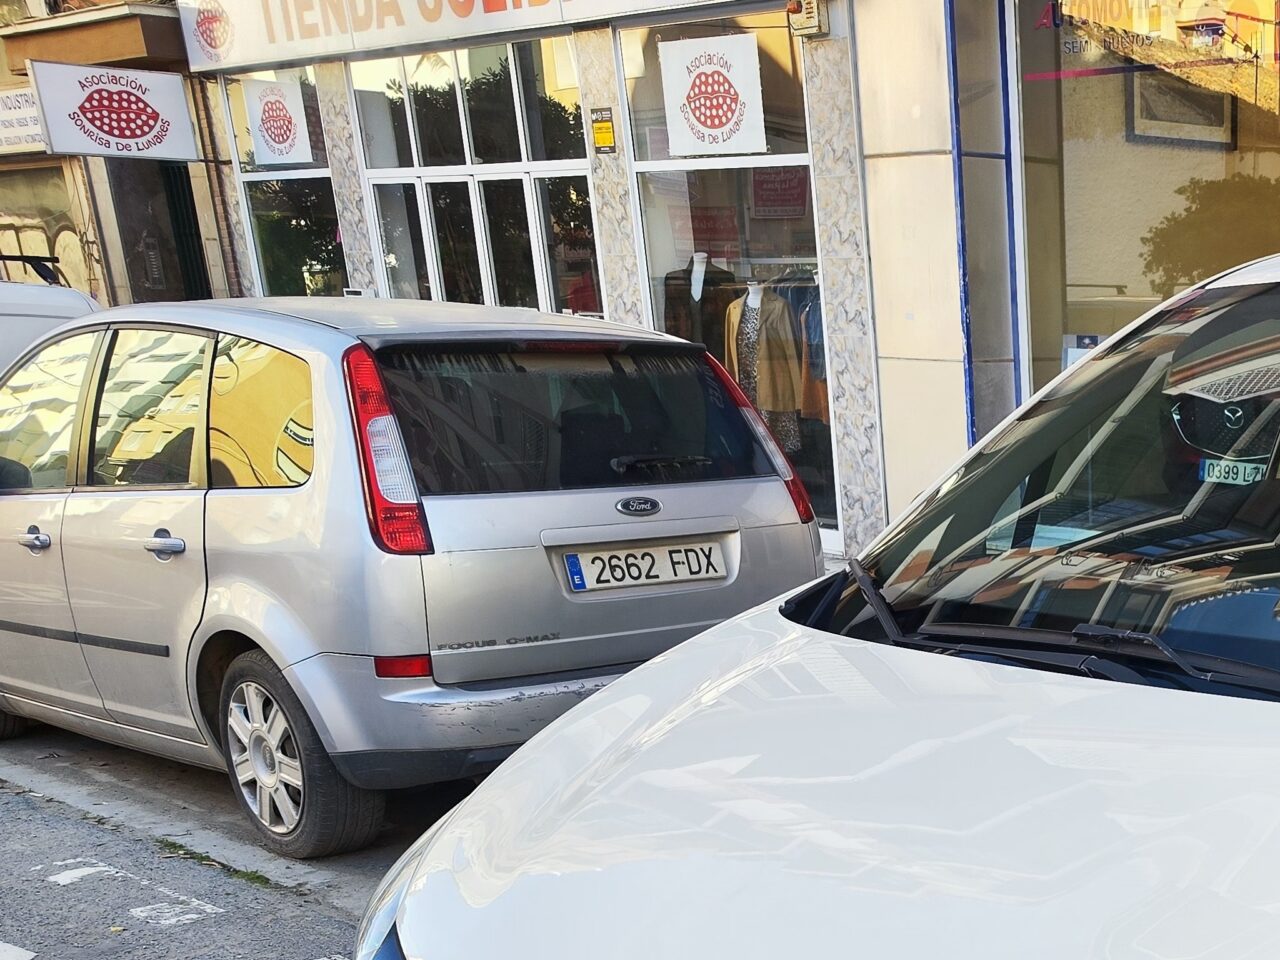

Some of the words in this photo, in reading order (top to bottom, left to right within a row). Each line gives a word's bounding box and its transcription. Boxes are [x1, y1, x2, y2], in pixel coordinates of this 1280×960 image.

[1063, 40, 1091, 55] SEMI
[1207, 463, 1239, 481] 0399
[630, 498, 652, 511] Ford
[575, 575, 581, 584] E
[590, 552, 660, 585] 2662
[668, 546, 719, 577] FDX
[437, 639, 497, 651] FOCUS
[506, 632, 561, 645] C-MAX
